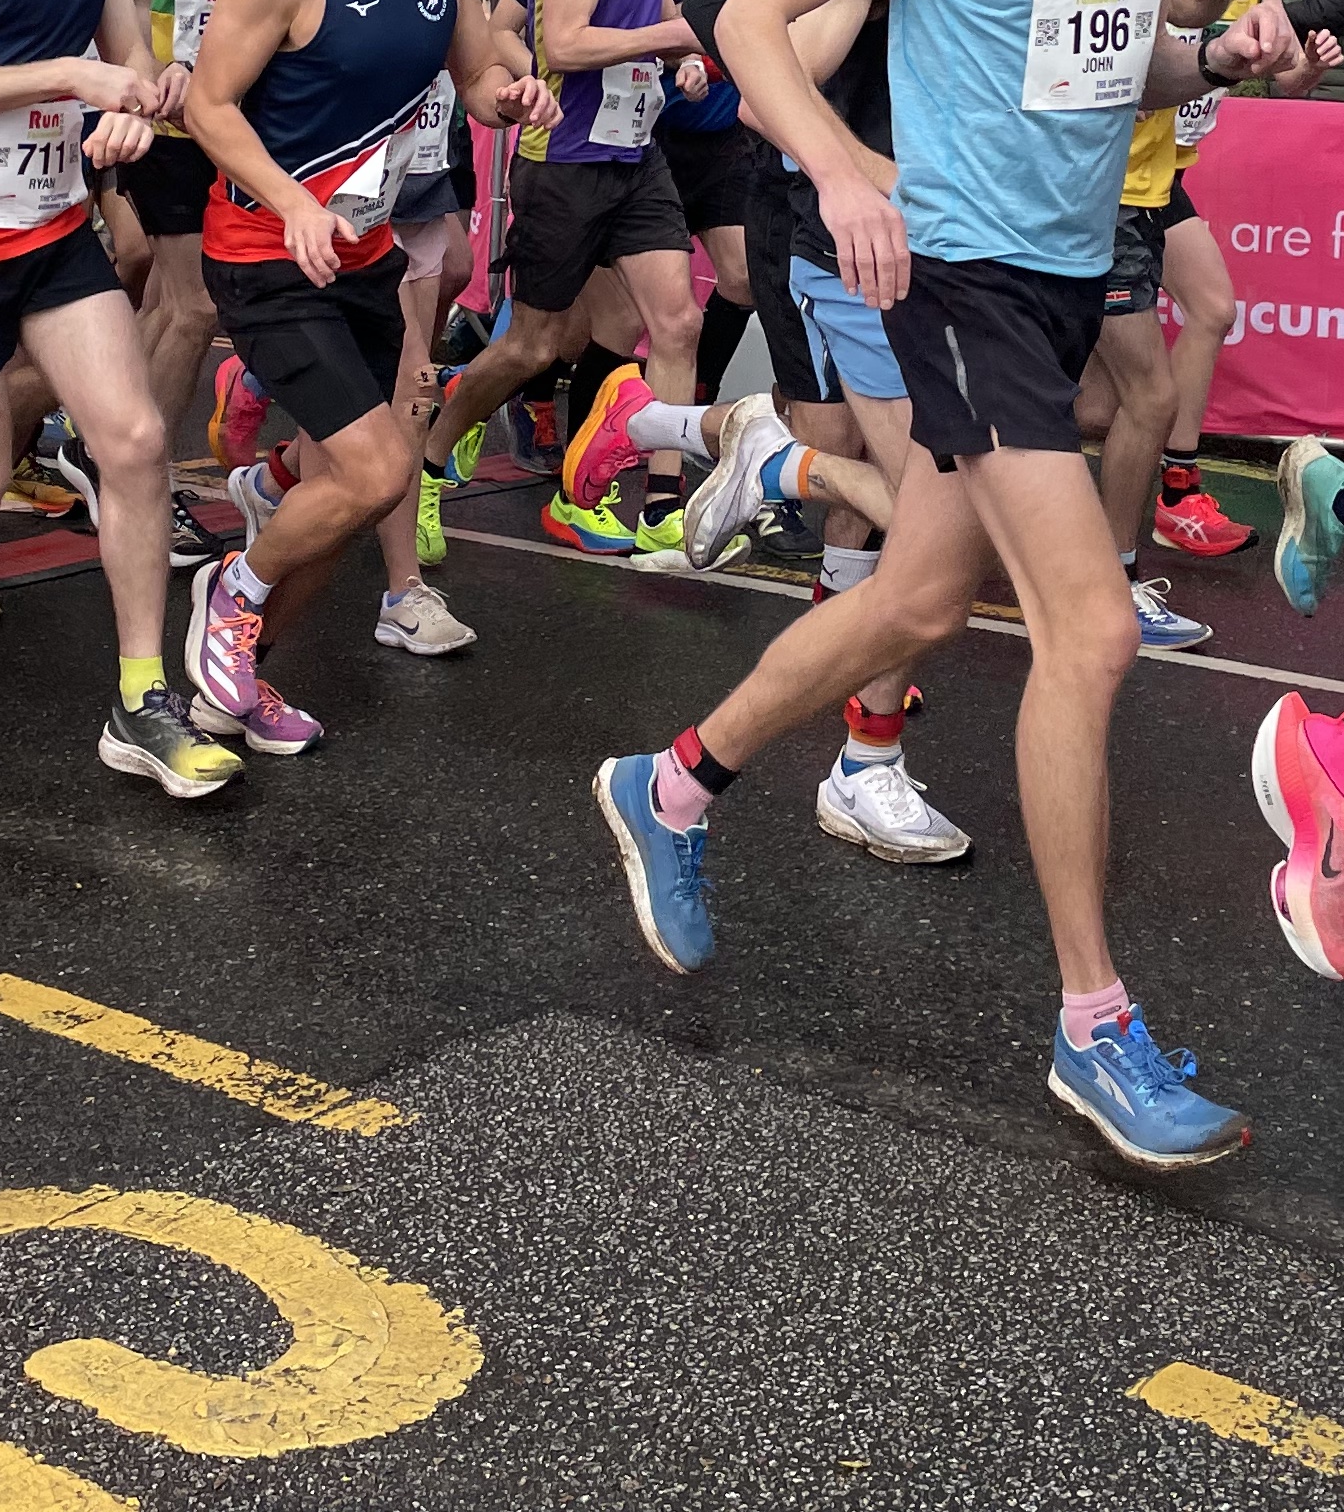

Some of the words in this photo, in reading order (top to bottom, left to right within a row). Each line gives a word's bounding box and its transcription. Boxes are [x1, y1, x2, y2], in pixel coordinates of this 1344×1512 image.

[1067, 7, 1131, 55] 196
[1082, 55, 1114, 73] JOHN
[634, 92, 646, 118] 4
[28, 110, 61, 130] Run
[17, 140, 65, 176] 711
[28, 177, 56, 190] RYAN
[351, 197, 386, 219] THOMAS
[1230, 221, 1312, 257] are
